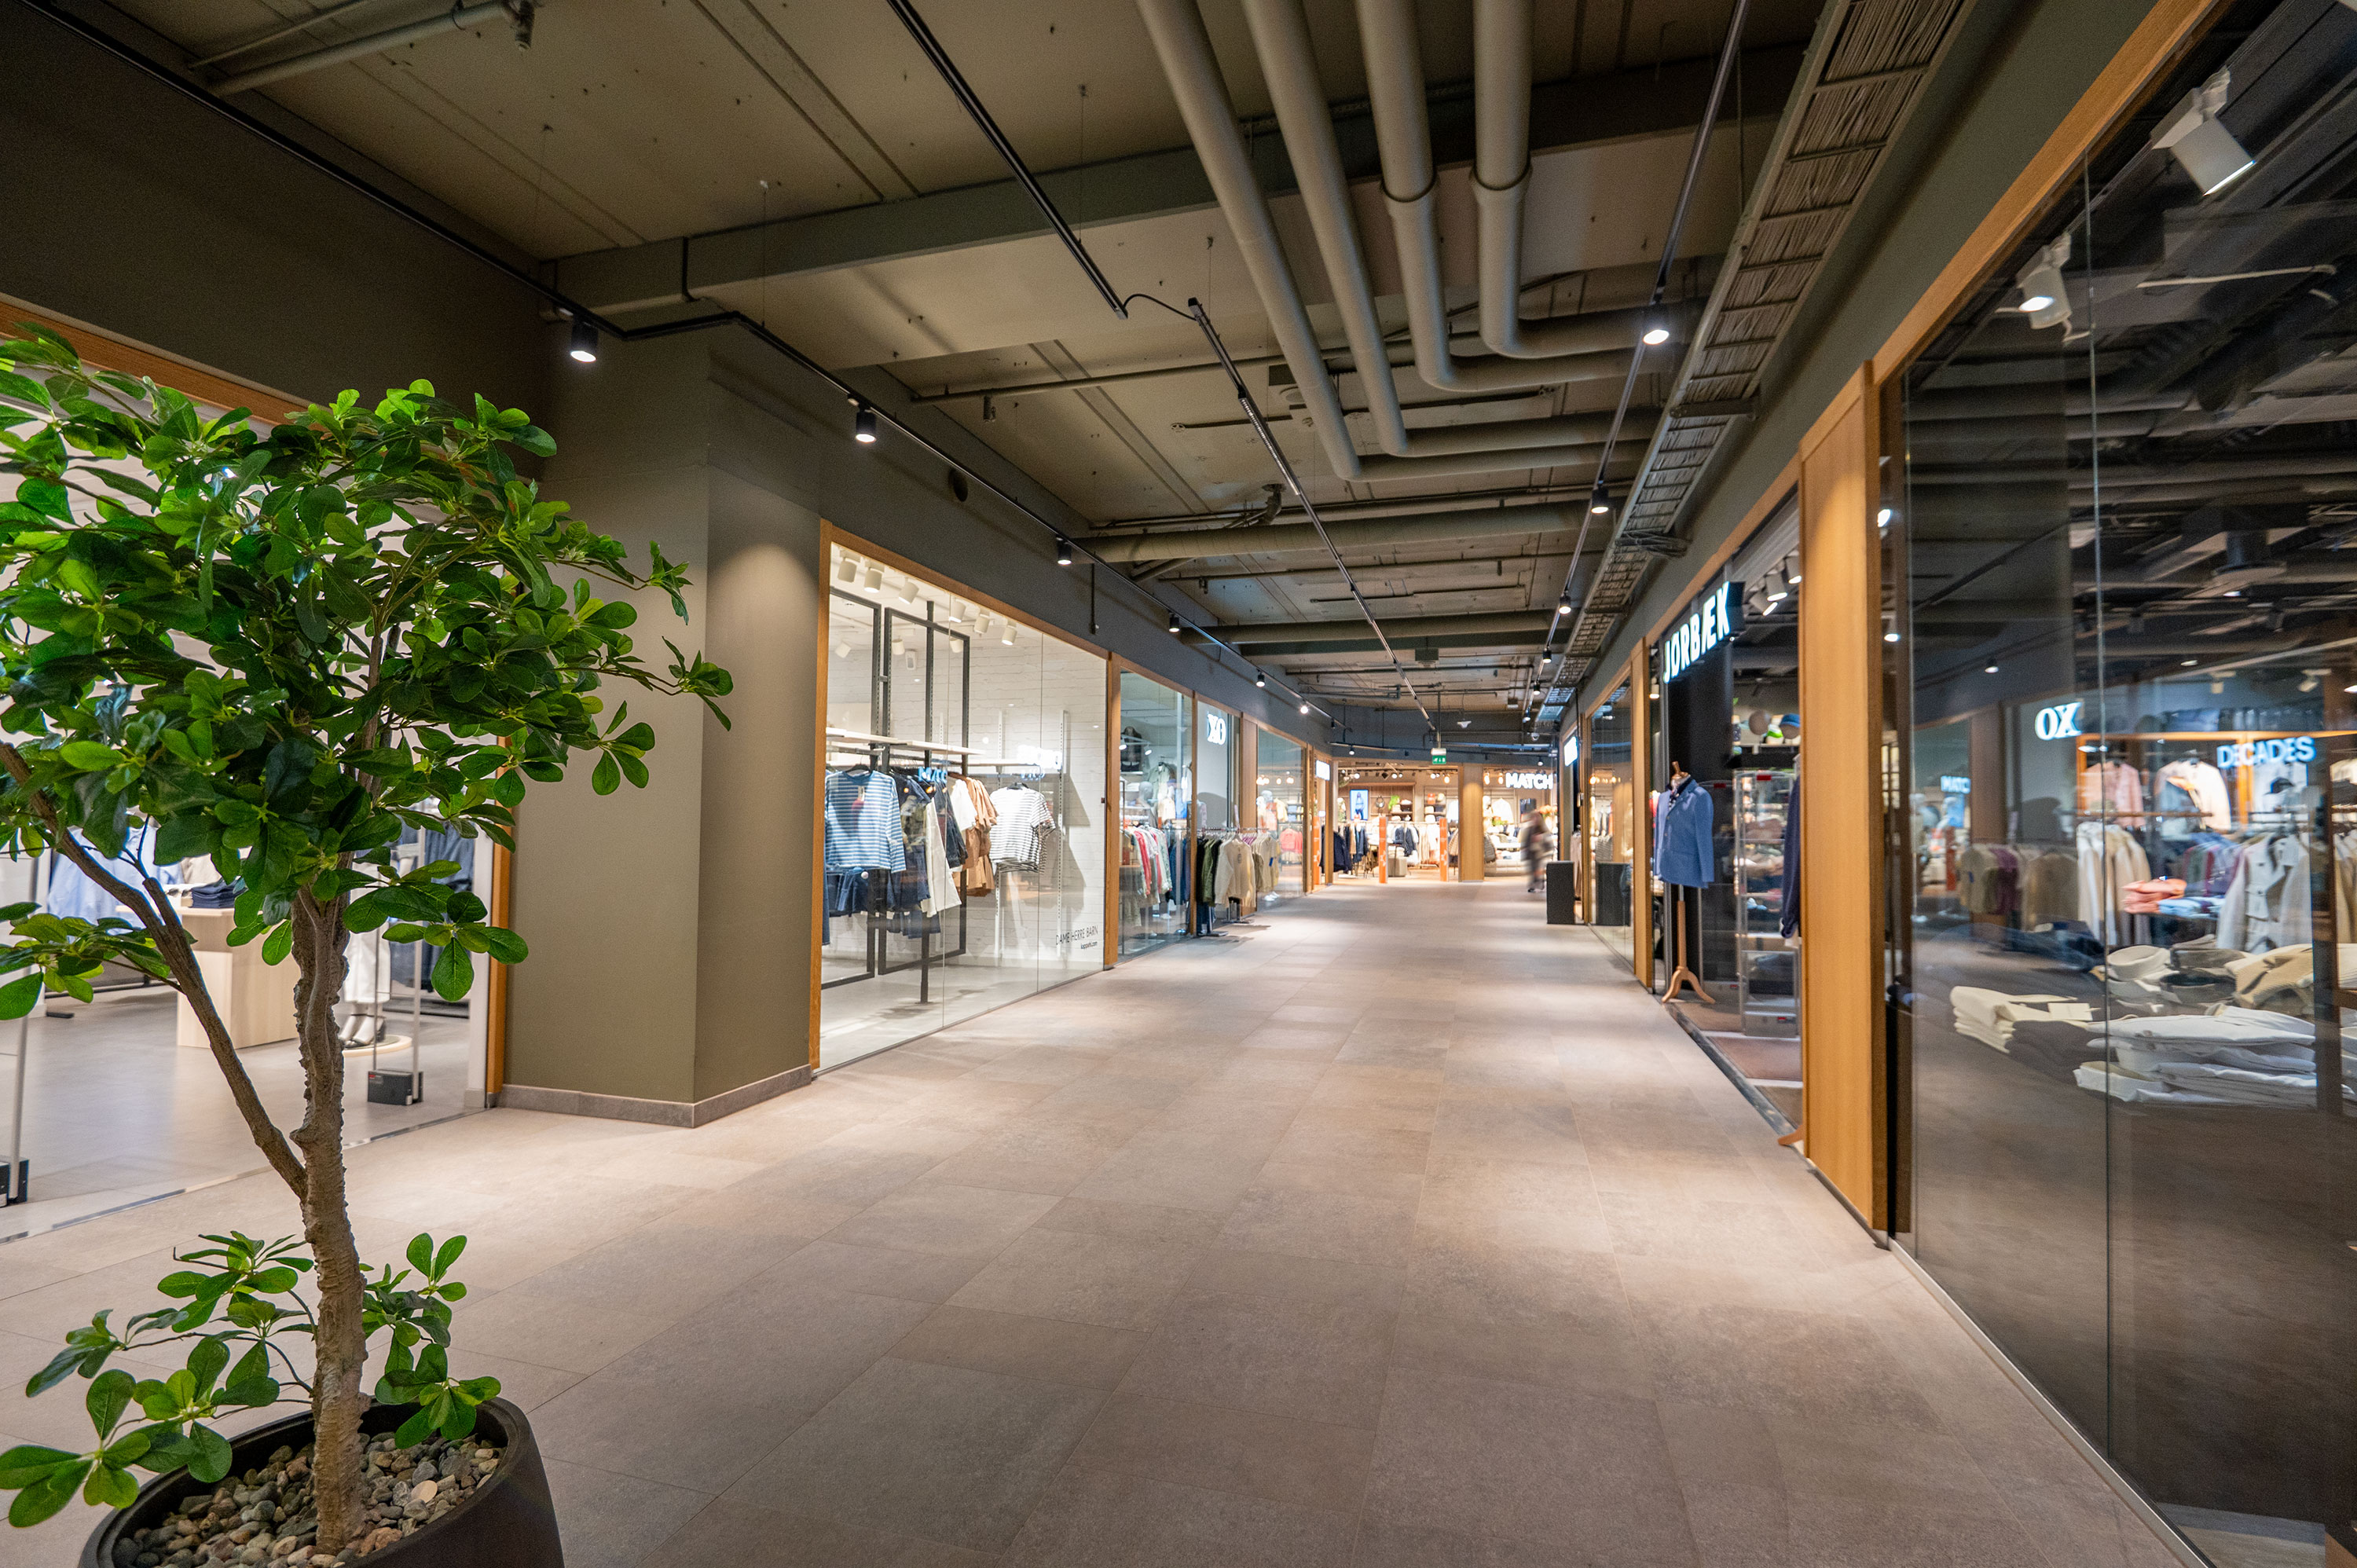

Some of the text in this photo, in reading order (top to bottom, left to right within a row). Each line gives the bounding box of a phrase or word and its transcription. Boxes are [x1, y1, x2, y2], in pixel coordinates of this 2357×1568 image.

[1663, 581, 1730, 684] JØRBÆK
[2216, 736, 2317, 769] DECADES
[1505, 772, 1553, 790] MATCH
[1056, 925, 1098, 946] DAME HERRE BARN
